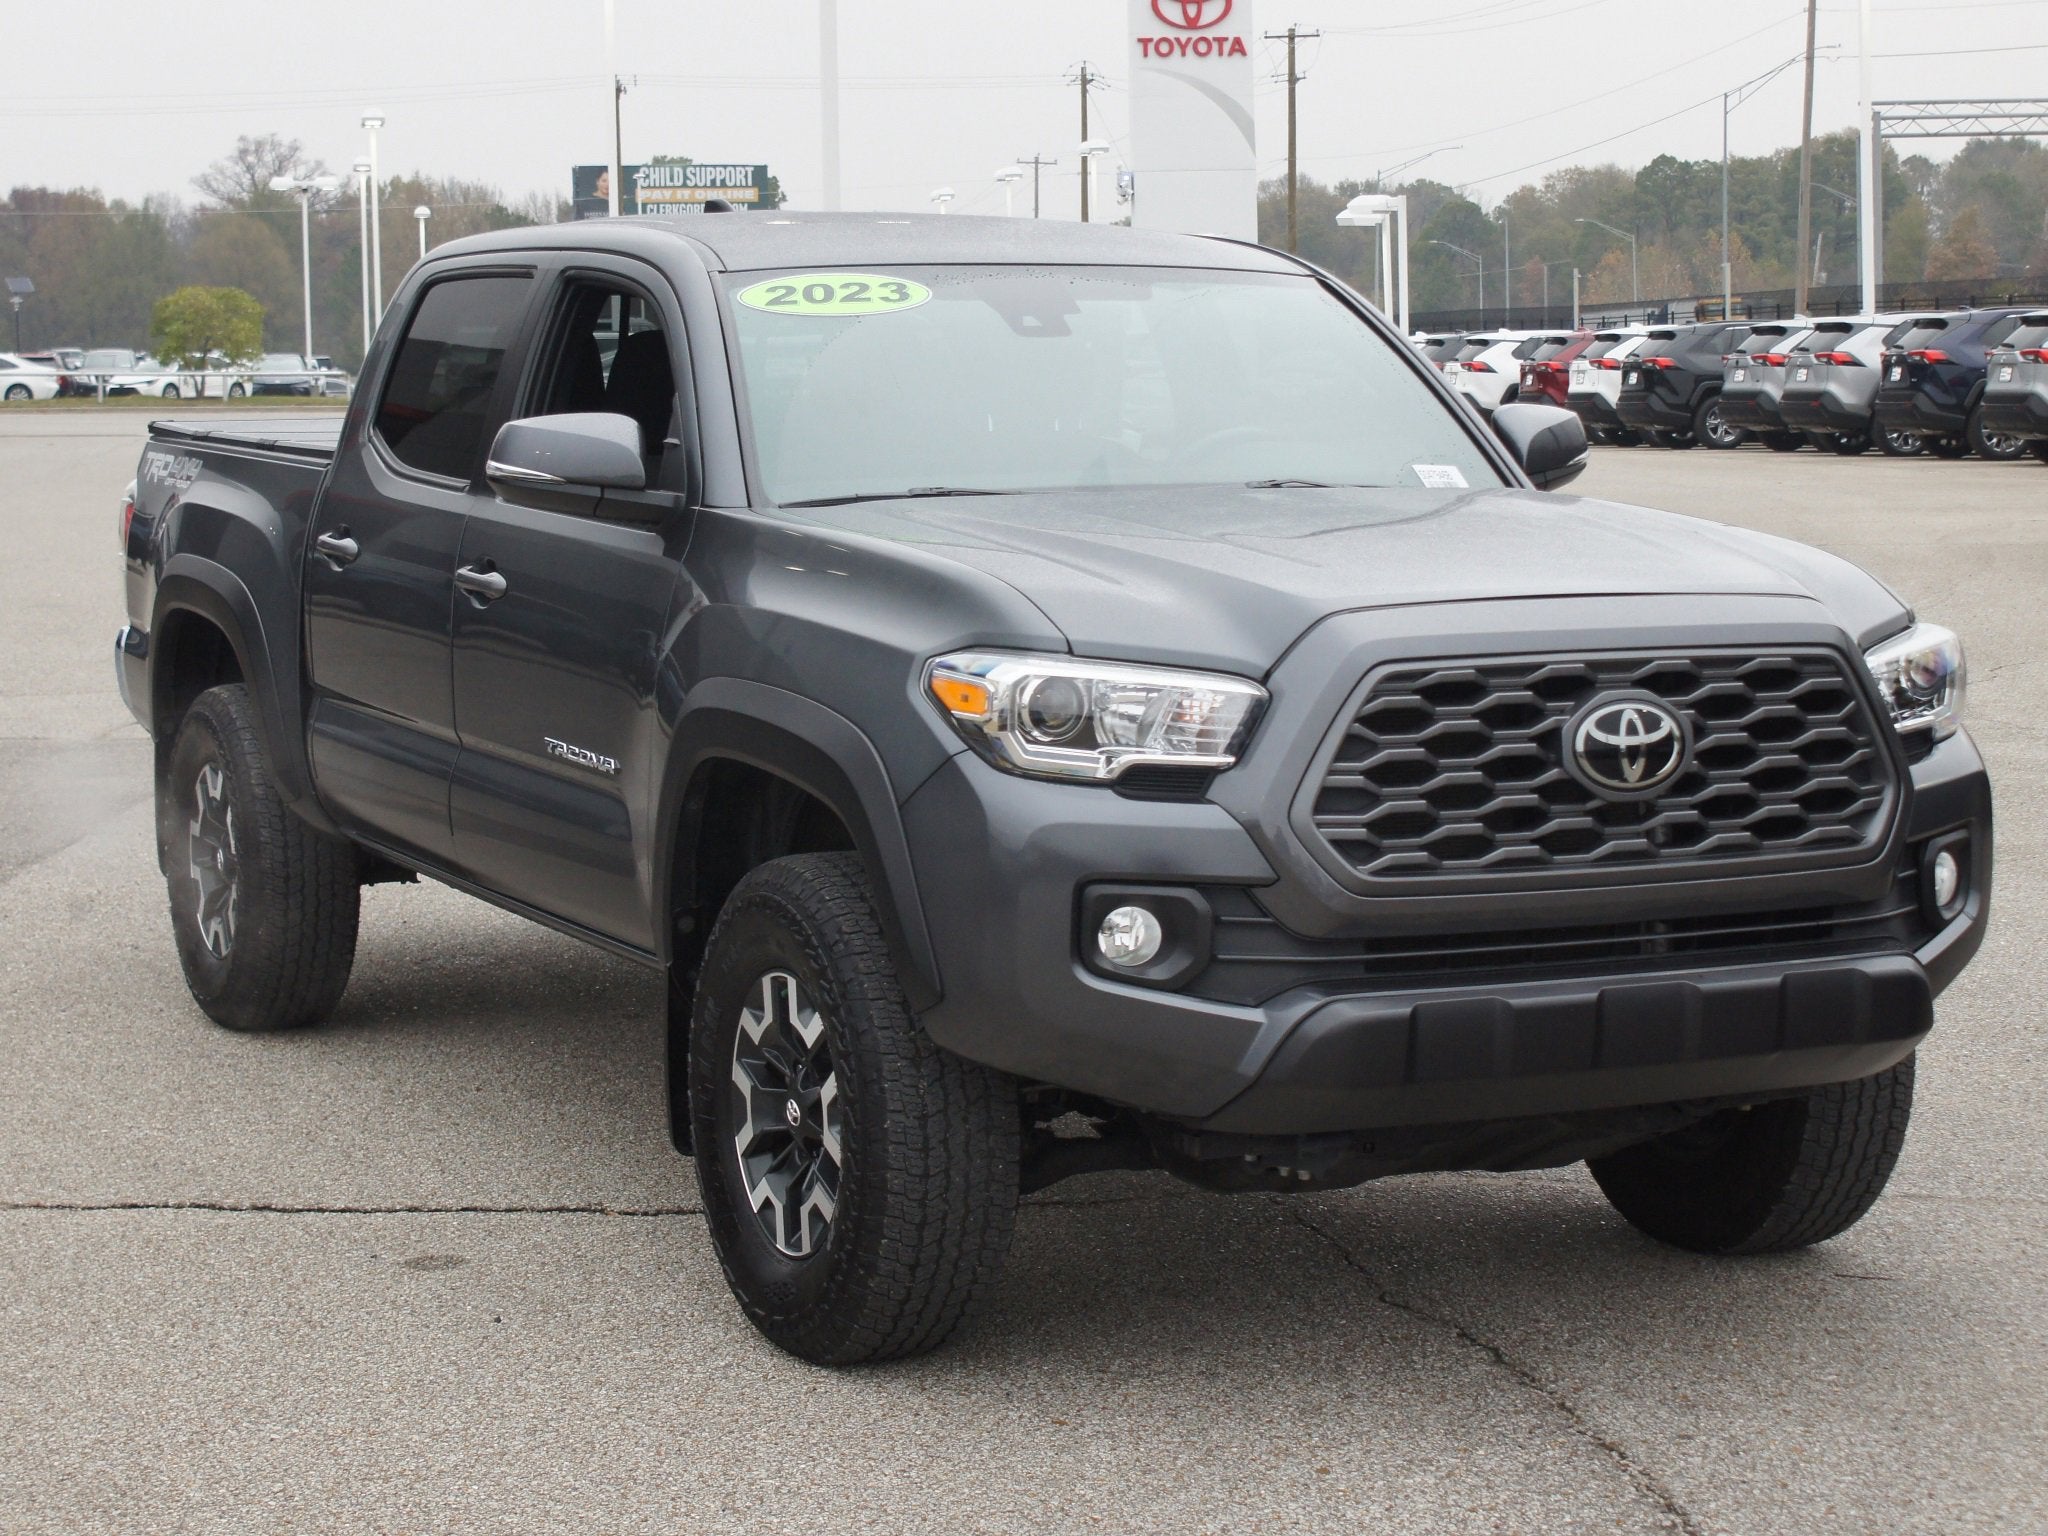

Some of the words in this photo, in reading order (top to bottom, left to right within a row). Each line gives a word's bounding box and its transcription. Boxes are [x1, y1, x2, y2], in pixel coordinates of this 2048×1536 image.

[1137, 36, 1248, 58] TOYOTA
[640, 166, 684, 187] CHILD
[686, 166, 754, 187] SUPPORT
[641, 190, 673, 200] PAY
[676, 190, 690, 200] IT
[694, 190, 754, 200] ONLINE
[764, 281, 911, 307] 2023
[144, 451, 175, 482] TRD
[543, 737, 616, 774] TACOMA
